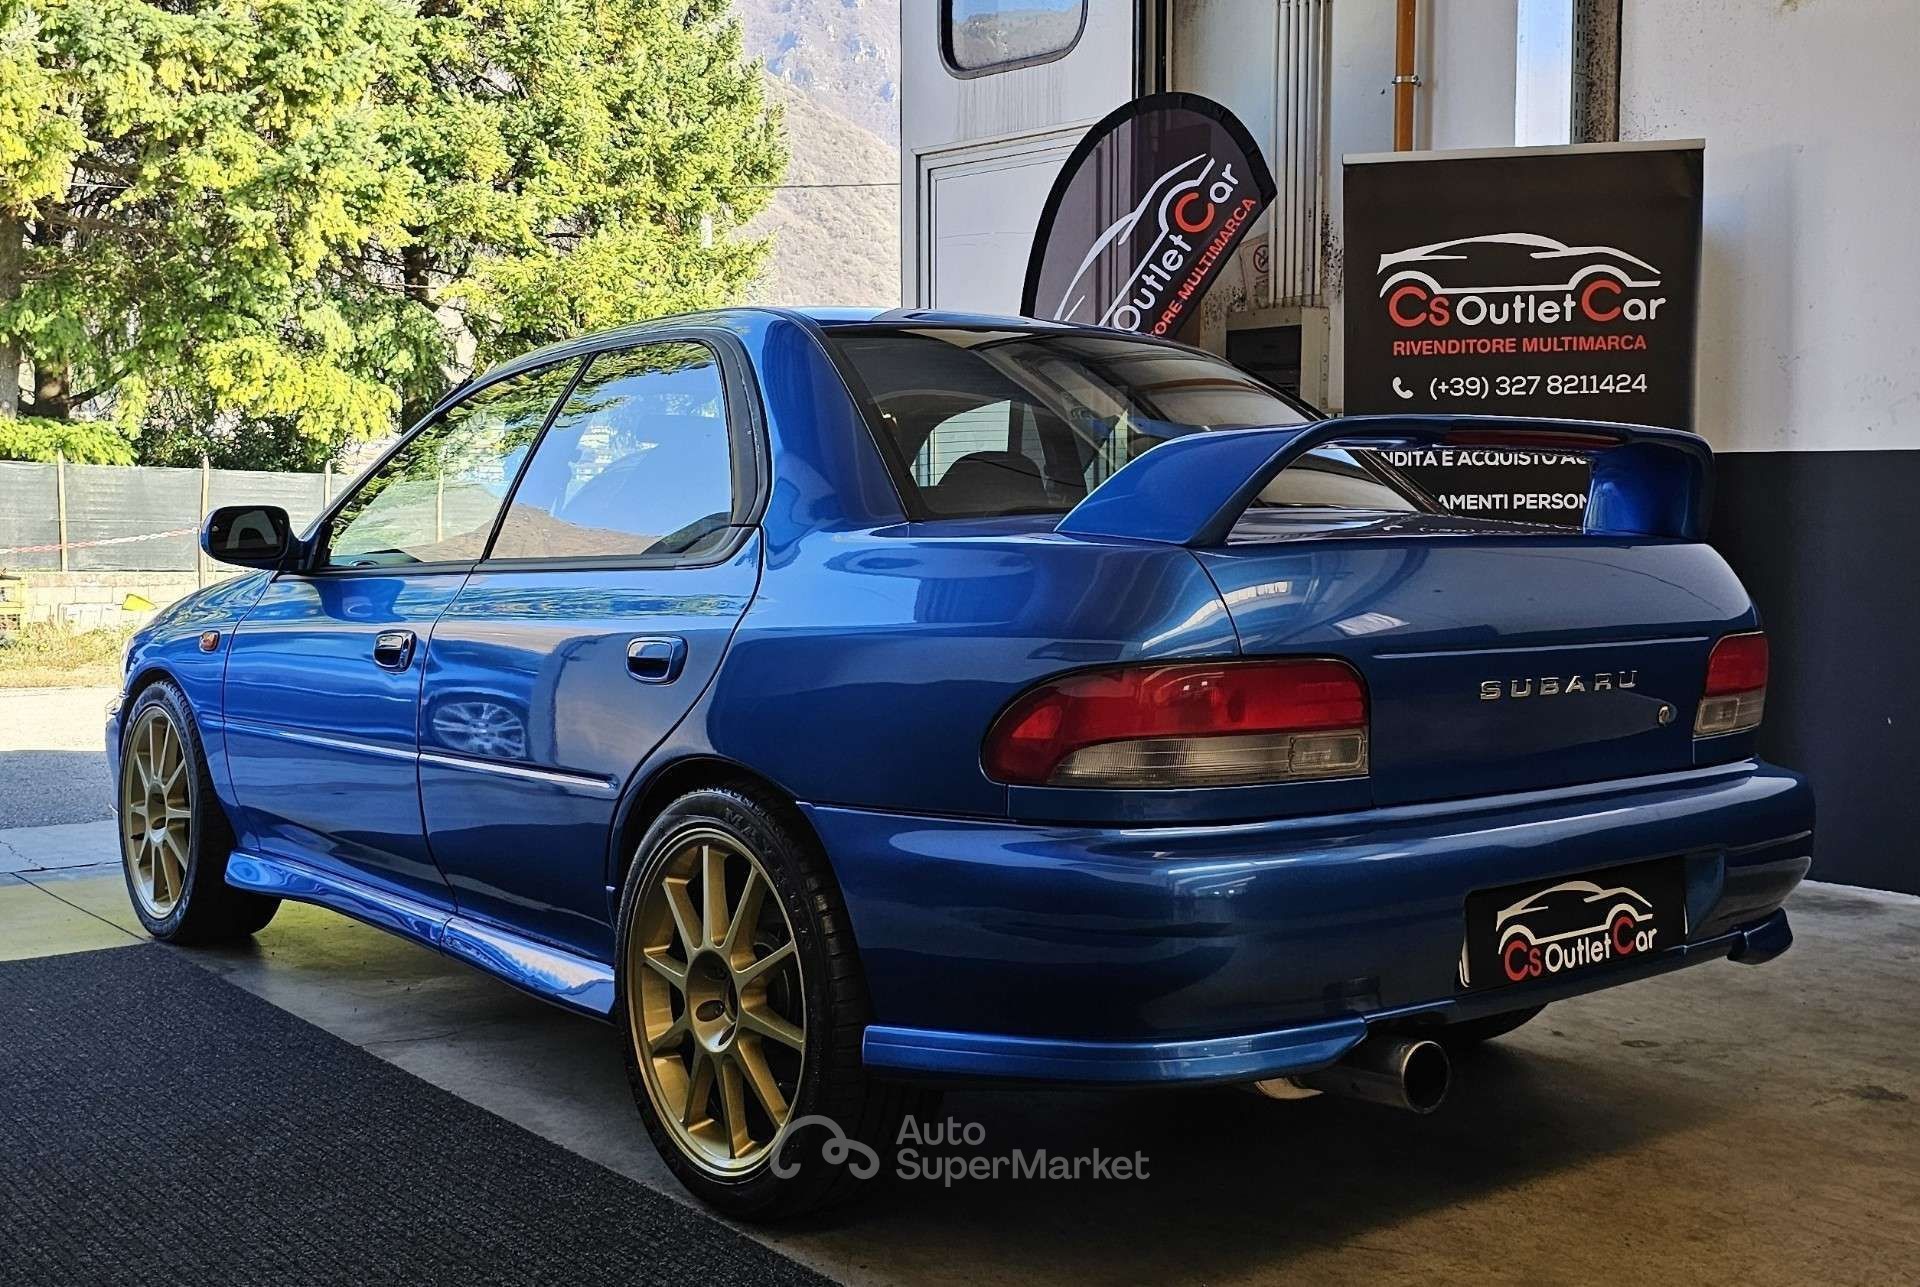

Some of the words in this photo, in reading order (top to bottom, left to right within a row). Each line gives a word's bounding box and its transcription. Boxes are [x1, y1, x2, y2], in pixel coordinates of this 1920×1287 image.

[1151, 299, 1183, 336] ORE
[1178, 198, 1257, 300] MULTIMARCA
[1393, 337, 1516, 356] RIVENDITORE
[1522, 335, 1647, 353] MULTIMARCA
[1429, 376, 1489, 400] (+39)
[1495, 376, 1540, 395] 327
[1546, 373, 1648, 395] 8211424
[1381, 451, 1439, 467] NDITA
[1442, 451, 1454, 467] E
[1438, 494, 1508, 510] AMENTI
[1480, 670, 1638, 700] SUBARU
